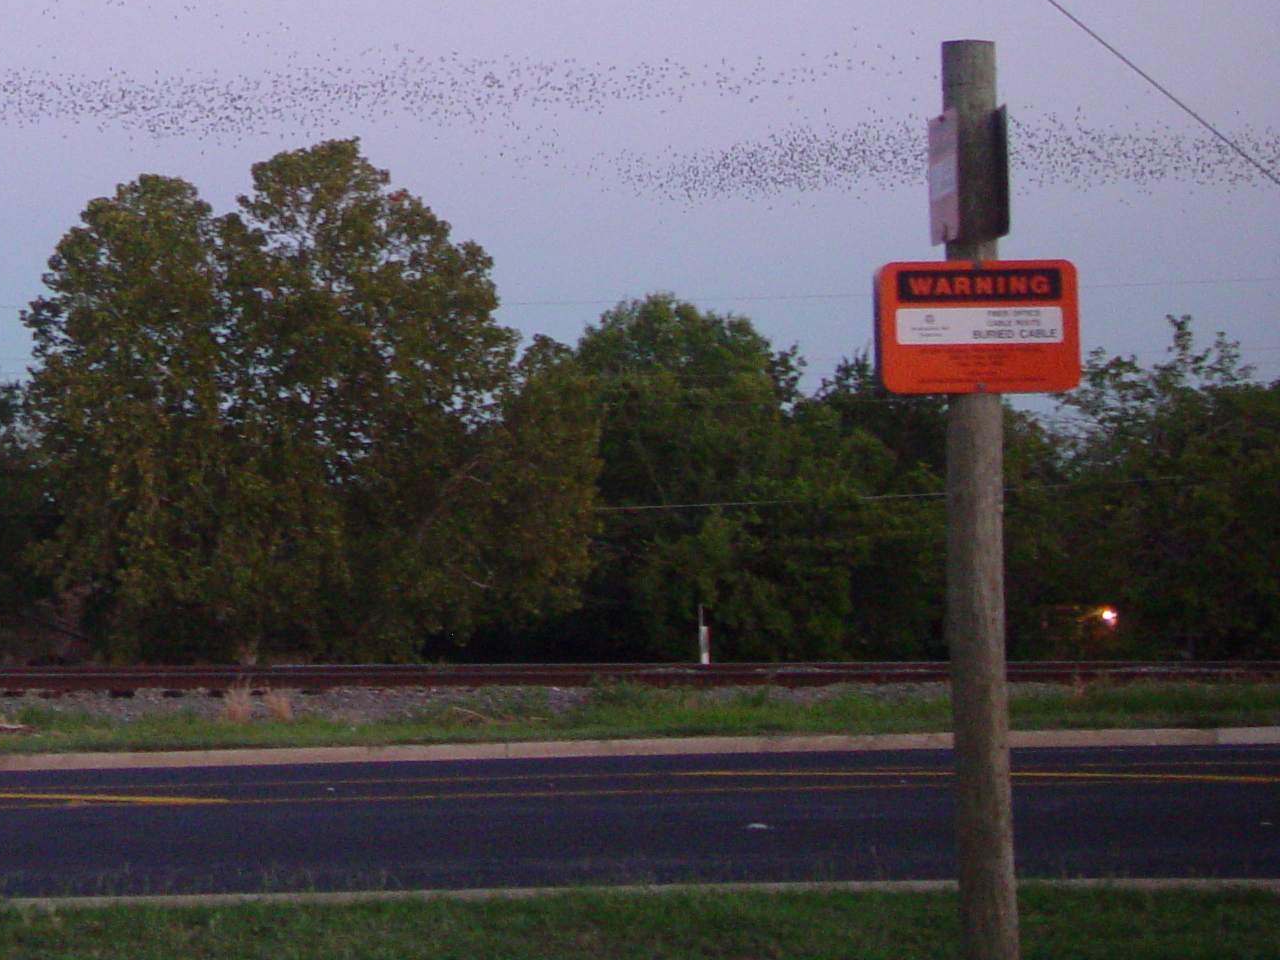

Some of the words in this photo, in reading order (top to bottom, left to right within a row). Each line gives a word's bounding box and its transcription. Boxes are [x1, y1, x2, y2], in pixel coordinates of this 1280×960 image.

[908, 276, 1050, 296] WARNING
[972, 329, 1015, 339] BURIED
[1020, 328, 1058, 338] CABLE
